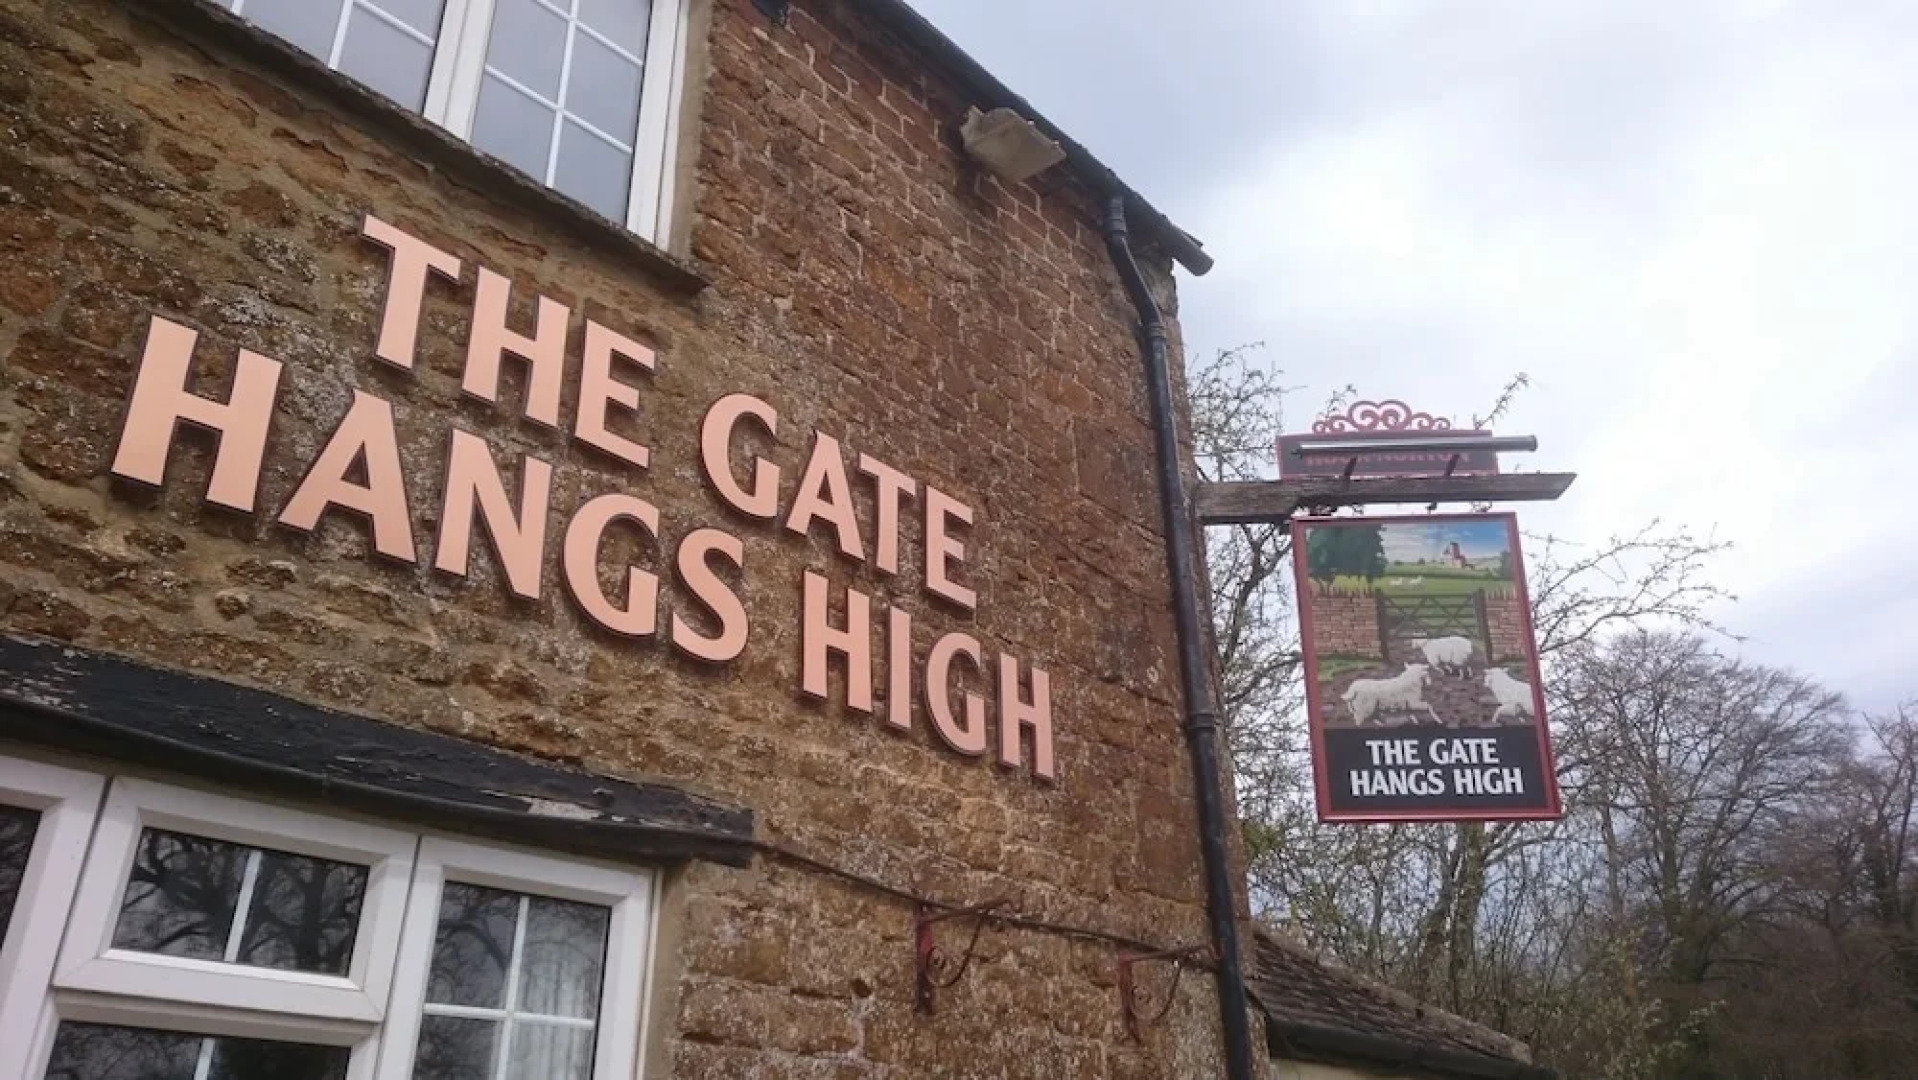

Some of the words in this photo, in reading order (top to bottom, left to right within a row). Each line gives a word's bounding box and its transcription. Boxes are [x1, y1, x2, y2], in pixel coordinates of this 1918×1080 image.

[362, 214, 656, 469] THE
[701, 393, 977, 609] GATE
[110, 315, 749, 661] HANGS
[803, 570, 1054, 780] HIGH
[1350, 768, 1445, 796] HANGS
[1453, 767, 1524, 795] HIGH
[1365, 739, 1421, 765] THE
[1429, 738, 1499, 764] GATE
